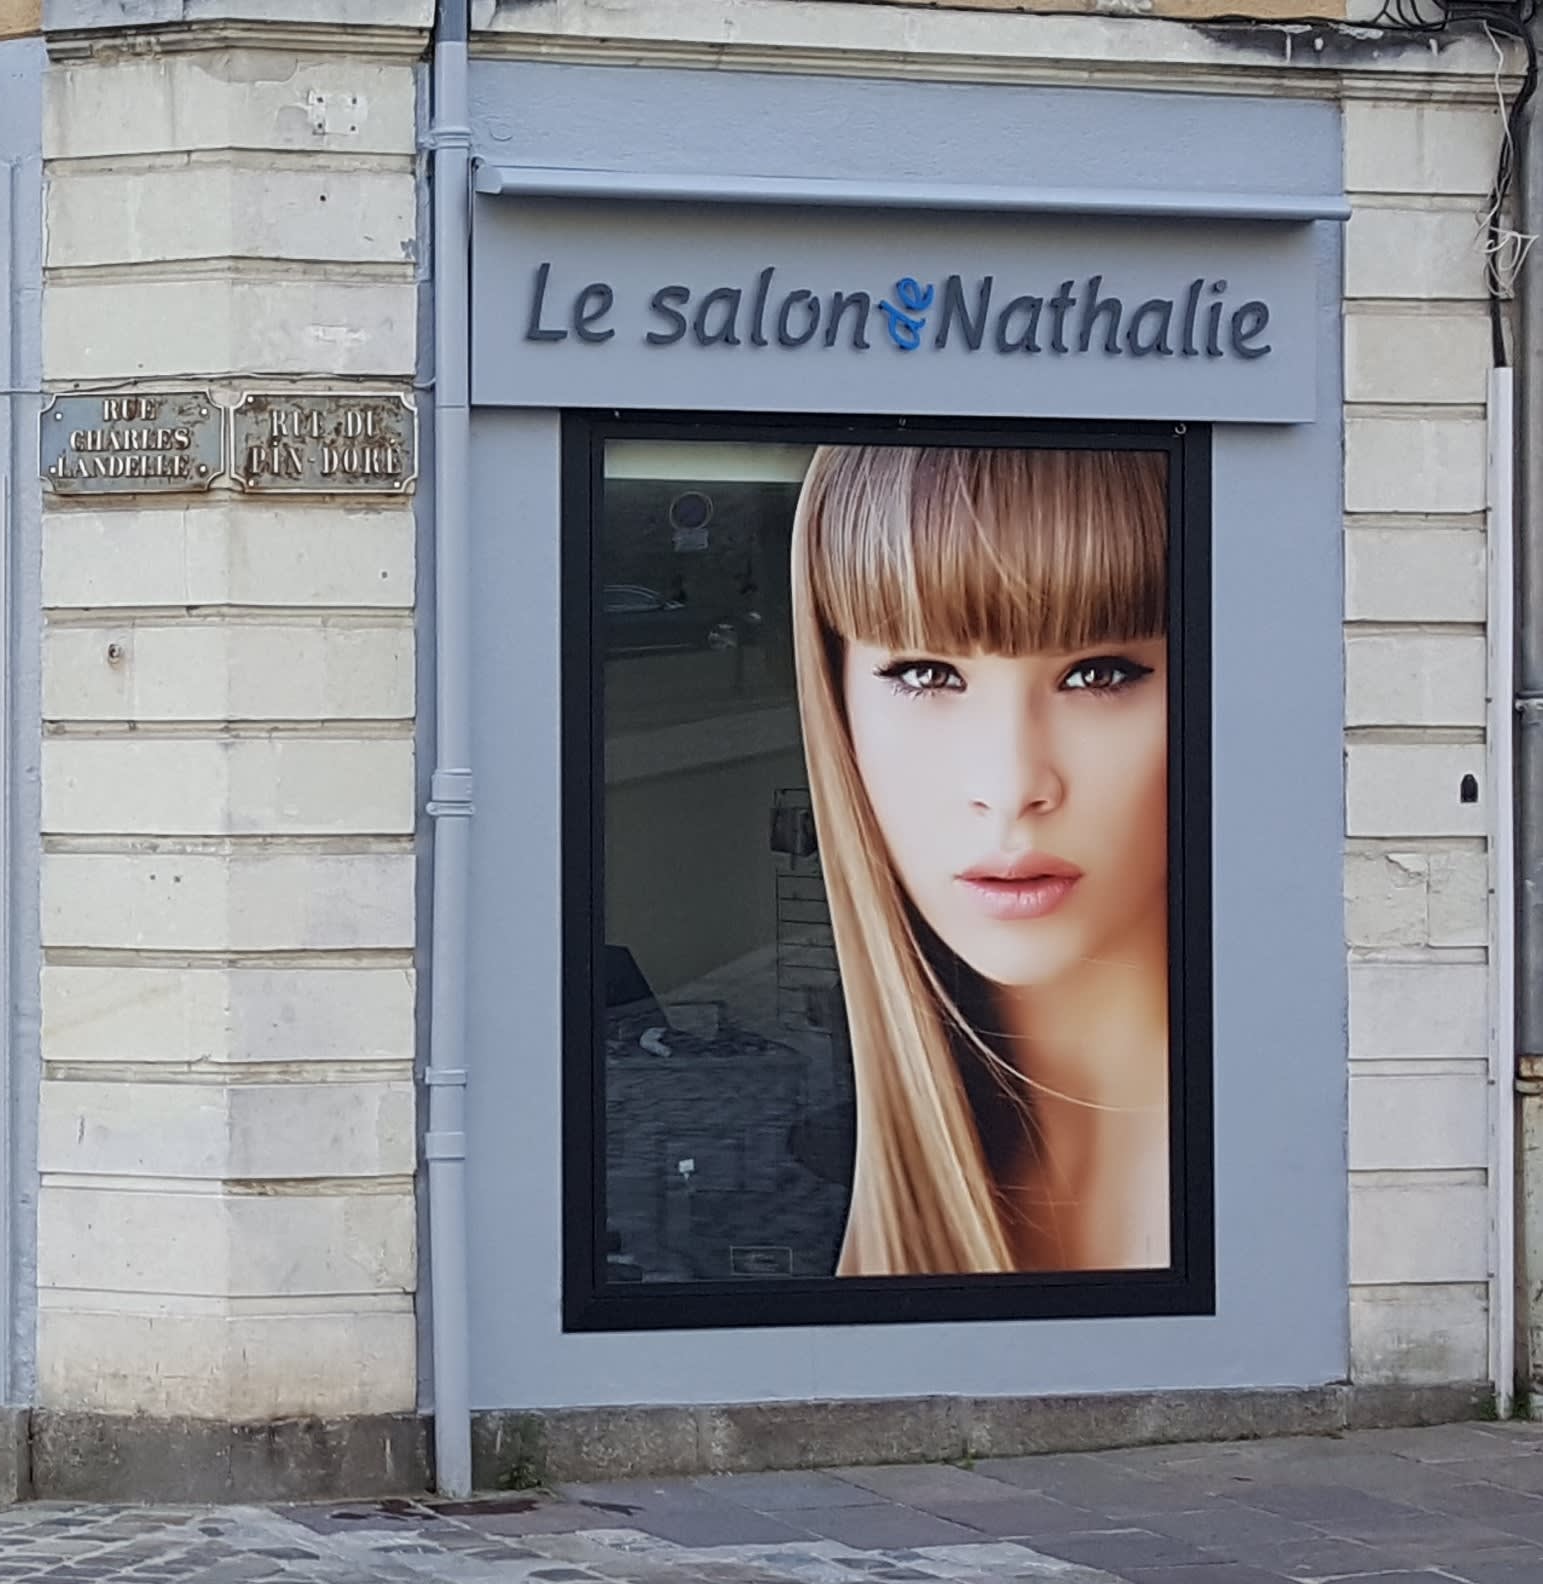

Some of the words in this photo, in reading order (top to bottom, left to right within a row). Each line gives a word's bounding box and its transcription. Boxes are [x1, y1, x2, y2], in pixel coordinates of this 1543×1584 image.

[524, 262, 617, 345] Le
[645, 266, 873, 351] salon
[878, 276, 937, 351] de
[935, 273, 1273, 360] Nathalie
[103, 398, 157, 421] RUE
[272, 409, 325, 437] RUE
[70, 428, 191, 451] CHARLES
[57, 454, 191, 478] LANDELLE
